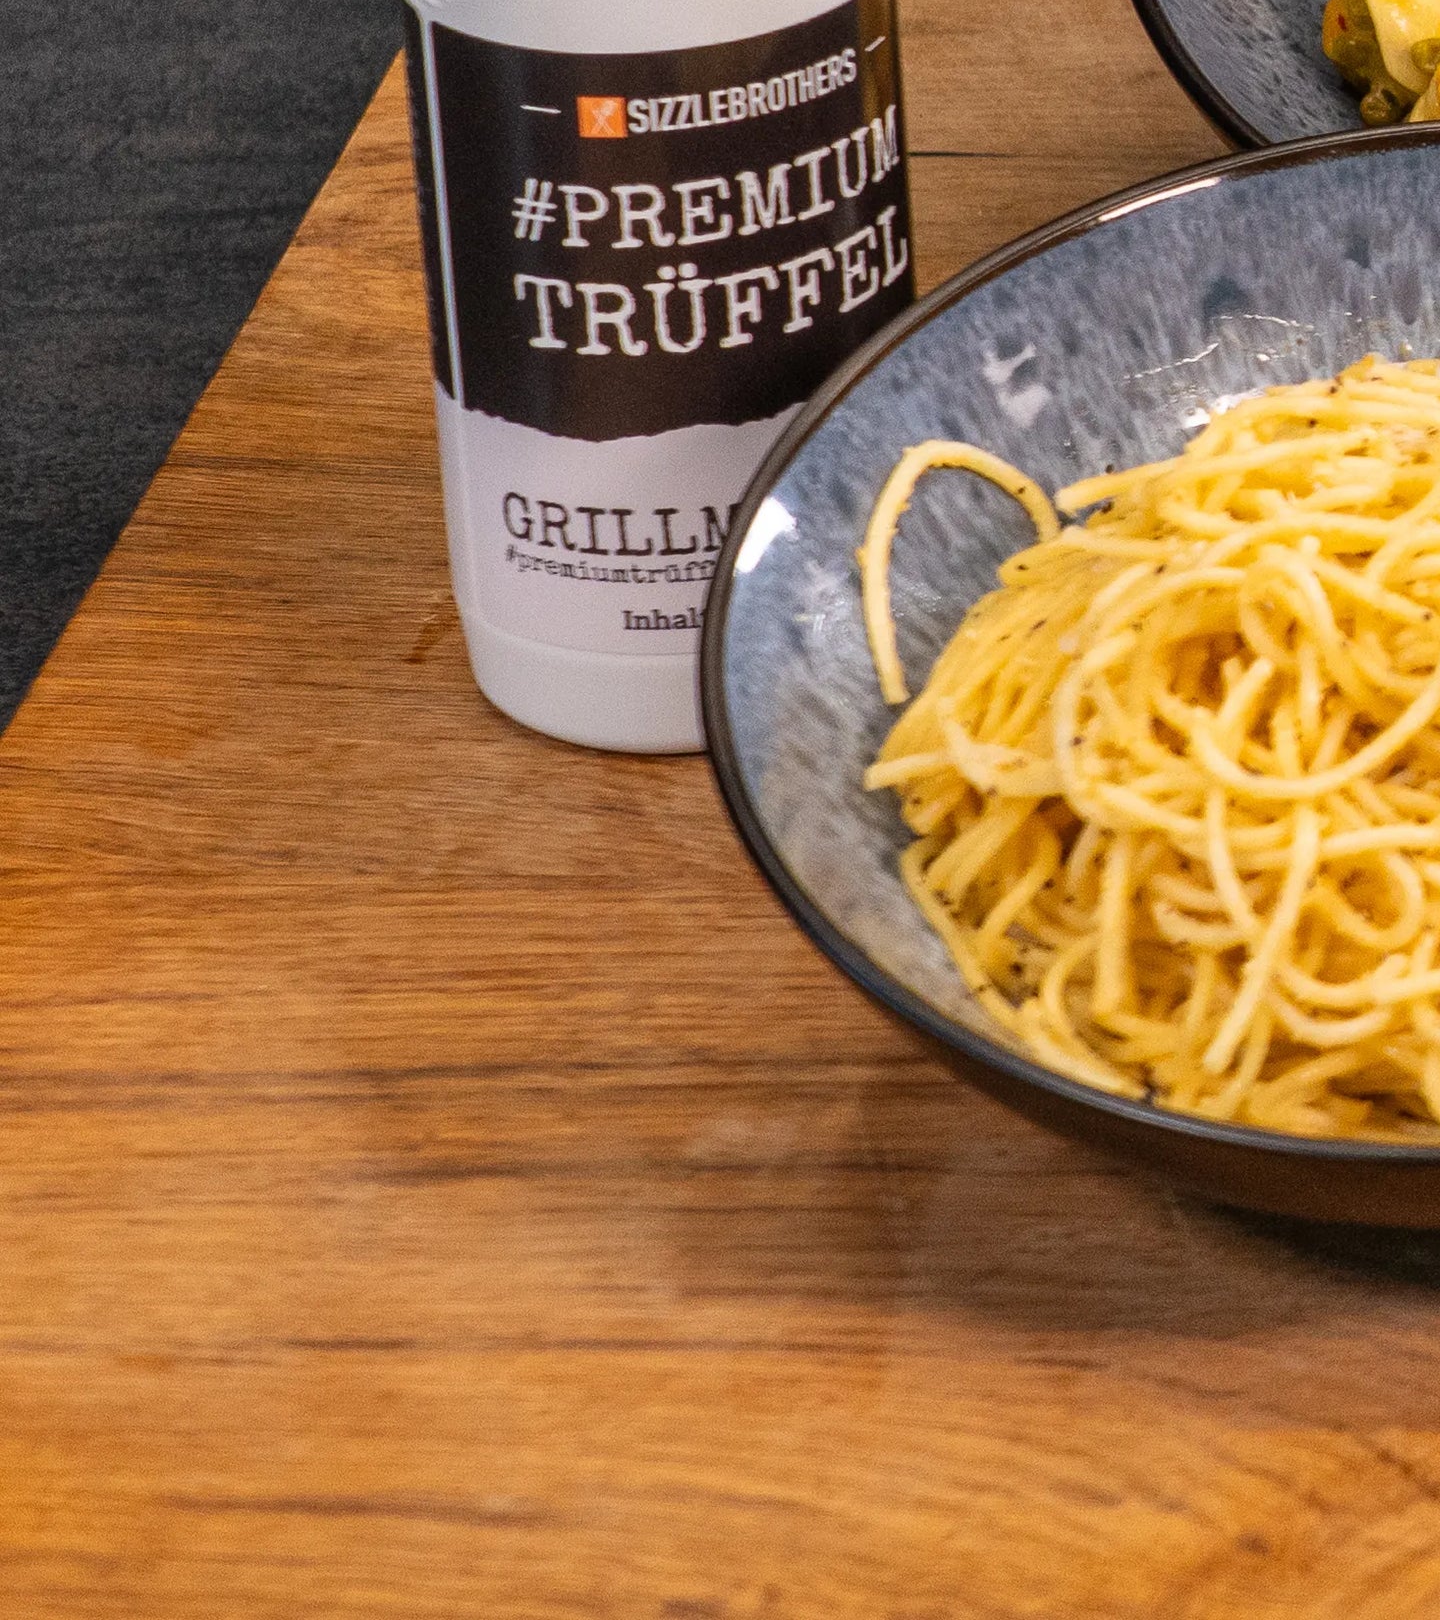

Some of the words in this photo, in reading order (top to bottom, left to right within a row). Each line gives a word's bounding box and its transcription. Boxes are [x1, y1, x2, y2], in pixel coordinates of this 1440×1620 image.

[627, 48, 857, 134] SIZZLEBROTHERS
[511, 105, 901, 248] #PREMIUM
[513, 206, 909, 356] TRÜFFEL
